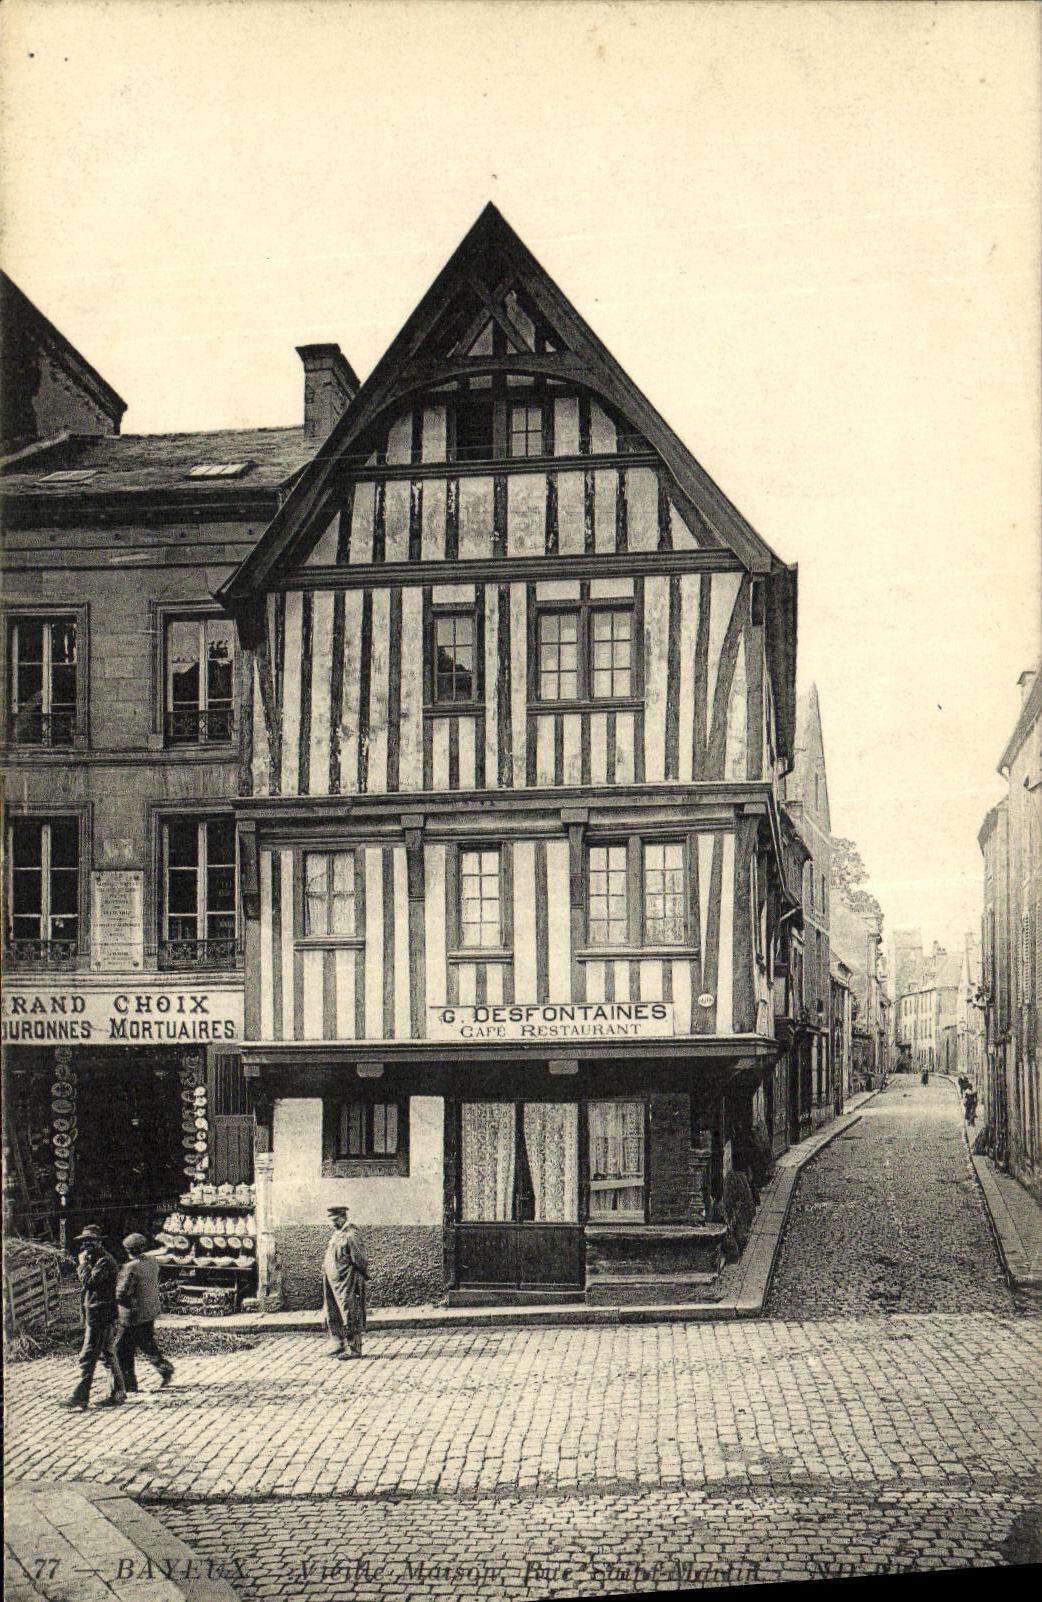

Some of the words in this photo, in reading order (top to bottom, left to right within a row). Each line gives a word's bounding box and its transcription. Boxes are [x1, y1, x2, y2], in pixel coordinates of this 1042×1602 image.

[3, 996, 86, 1015] RAND
[113, 995, 209, 1014] CHOIX
[474, 1004, 667, 1023] DESFONTAINES
[109, 1018, 235, 1039] MORTUAIRES
